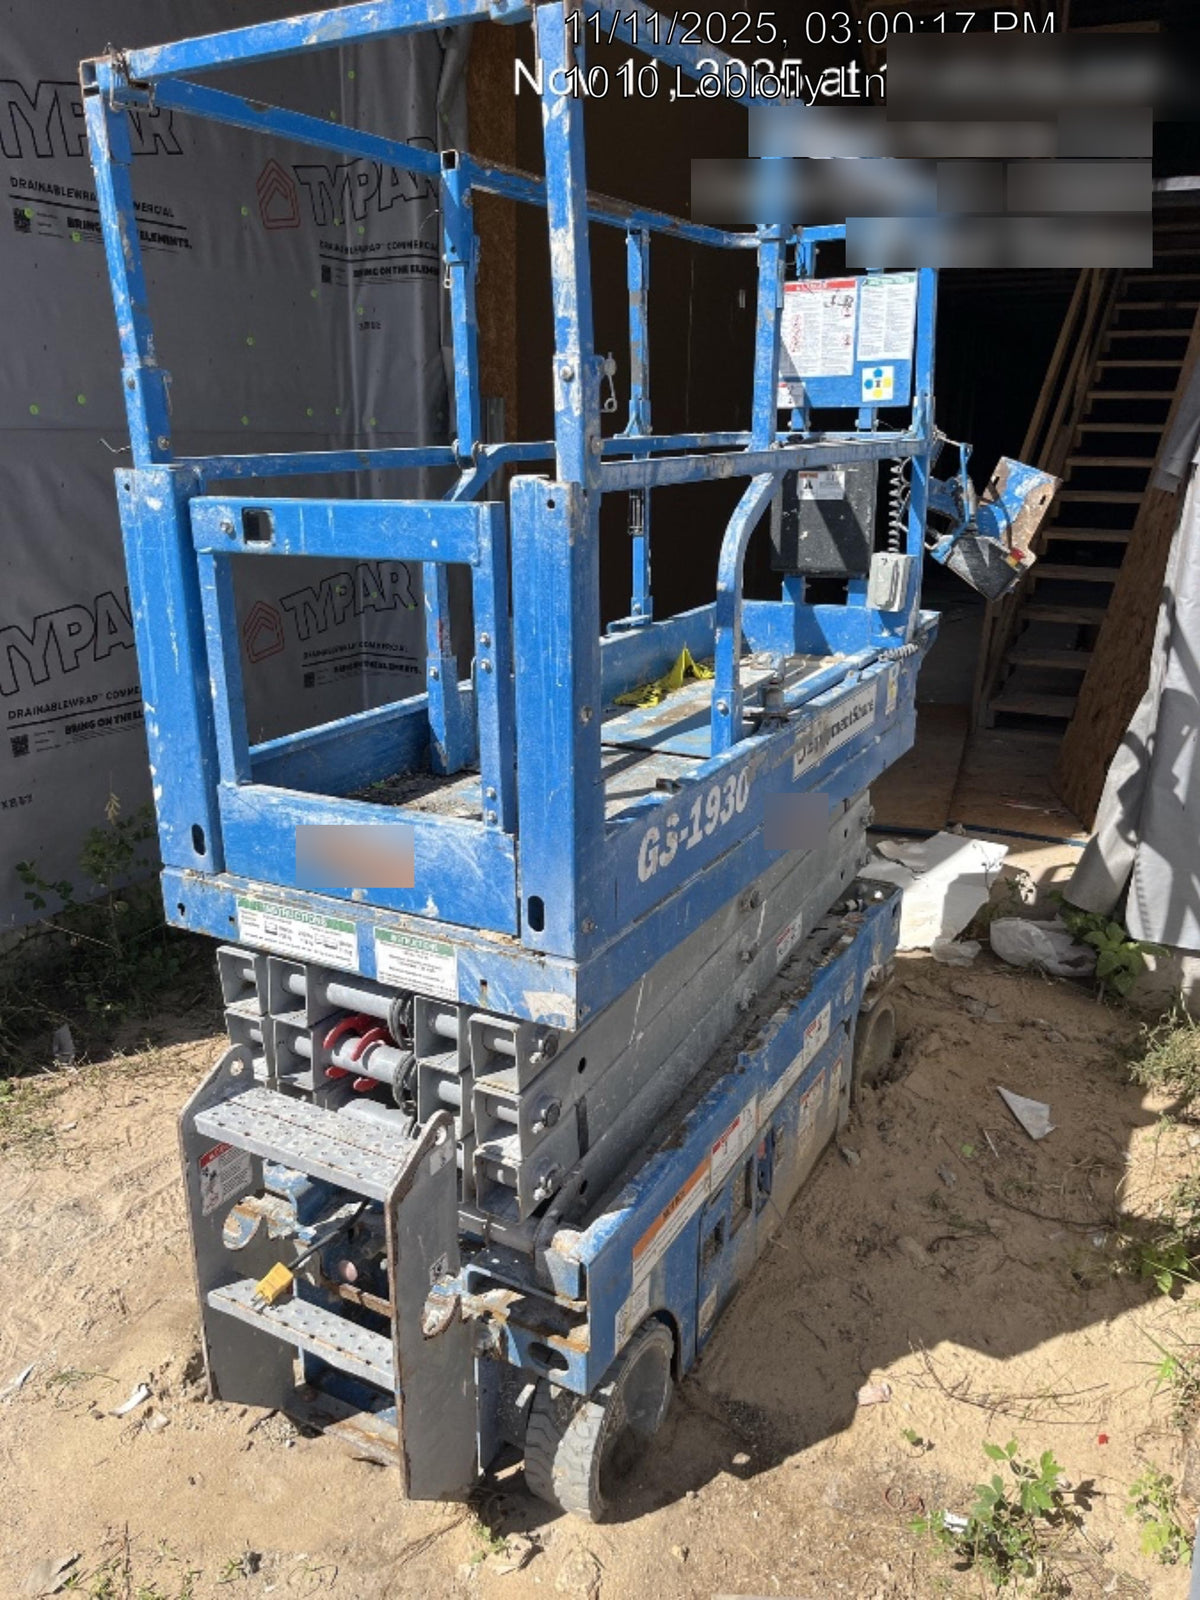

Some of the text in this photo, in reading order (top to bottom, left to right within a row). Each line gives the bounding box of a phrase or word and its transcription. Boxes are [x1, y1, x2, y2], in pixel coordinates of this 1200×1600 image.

[0, 79, 184, 159] TYPR
[9, 175, 98, 202] DRAINABLEWRA
[279, 560, 418, 641] TYPAR
[0, 586, 136, 696] TYPA
[106, 686, 141, 701] COMME
